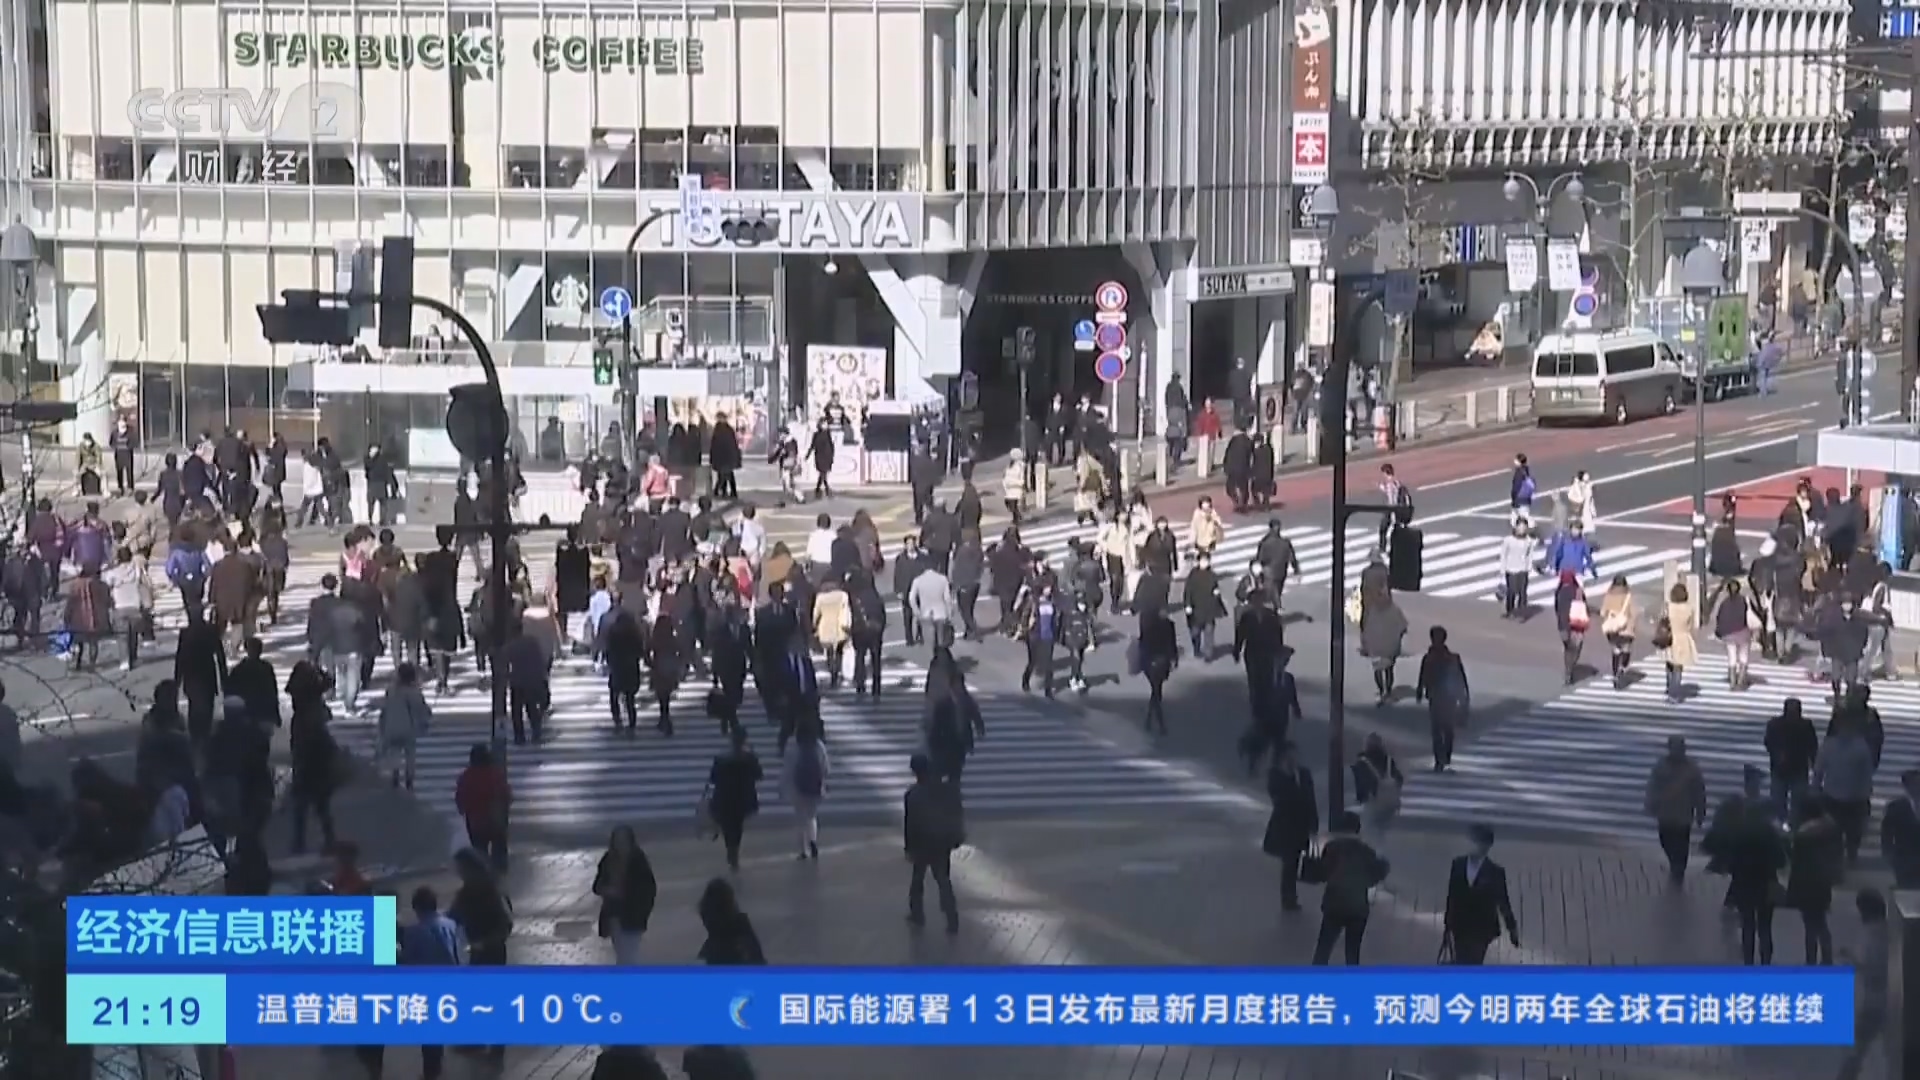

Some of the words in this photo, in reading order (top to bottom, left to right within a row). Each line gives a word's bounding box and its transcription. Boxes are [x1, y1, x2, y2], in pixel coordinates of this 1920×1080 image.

[234, 31, 504, 70] STARBUCKS
[533, 36, 704, 74] COFFEE
[1297, 135, 1324, 163] 本
